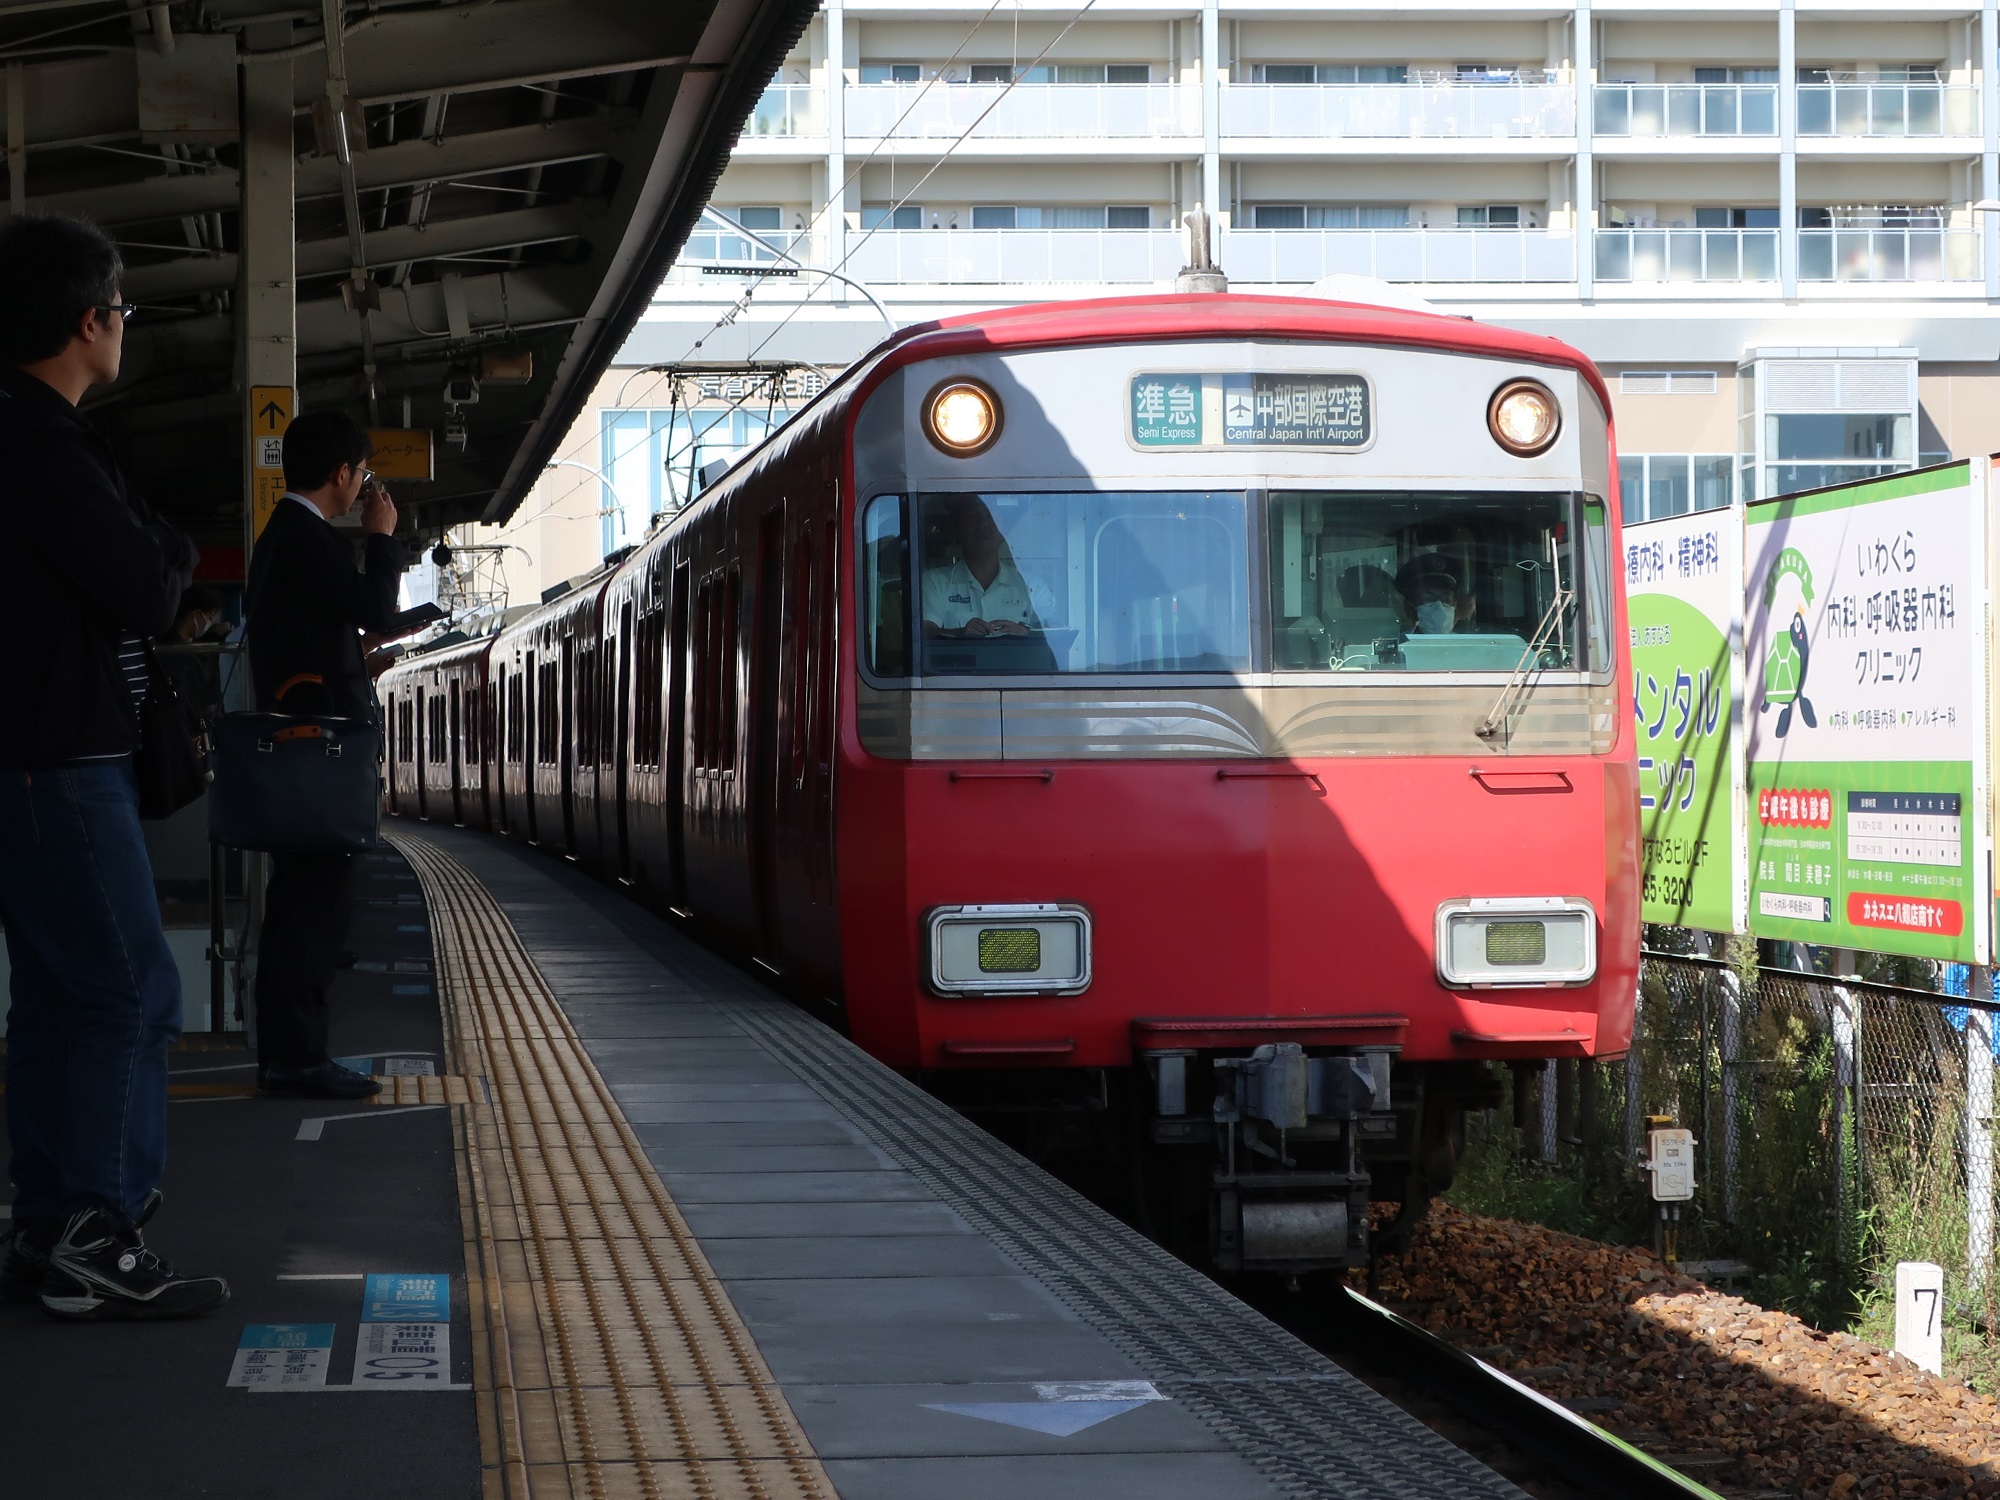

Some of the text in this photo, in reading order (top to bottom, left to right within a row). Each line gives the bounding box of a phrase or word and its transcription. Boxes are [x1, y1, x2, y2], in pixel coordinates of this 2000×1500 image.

[1136, 382, 1197, 426] 準急
[1256, 384, 1363, 426] 中部国際空港
[1138, 427, 1196, 441] Semi Express
[1226, 427, 1363, 441] Central Japan Int'l Airport
[259, 477, 268, 511] Elevator
[1624, 531, 1718, 584] 療内科・精神科
[1857, 530, 1917, 577] いわくら
[1827, 583, 1955, 640] 内科・呼吸器内科
[1855, 646, 1922, 686] クリニック
[1760, 795, 1830, 821] 土曜午後も診療
[1913, 1288, 1938, 1337] 7
[391, 1325, 437, 1353] 乗車位置
